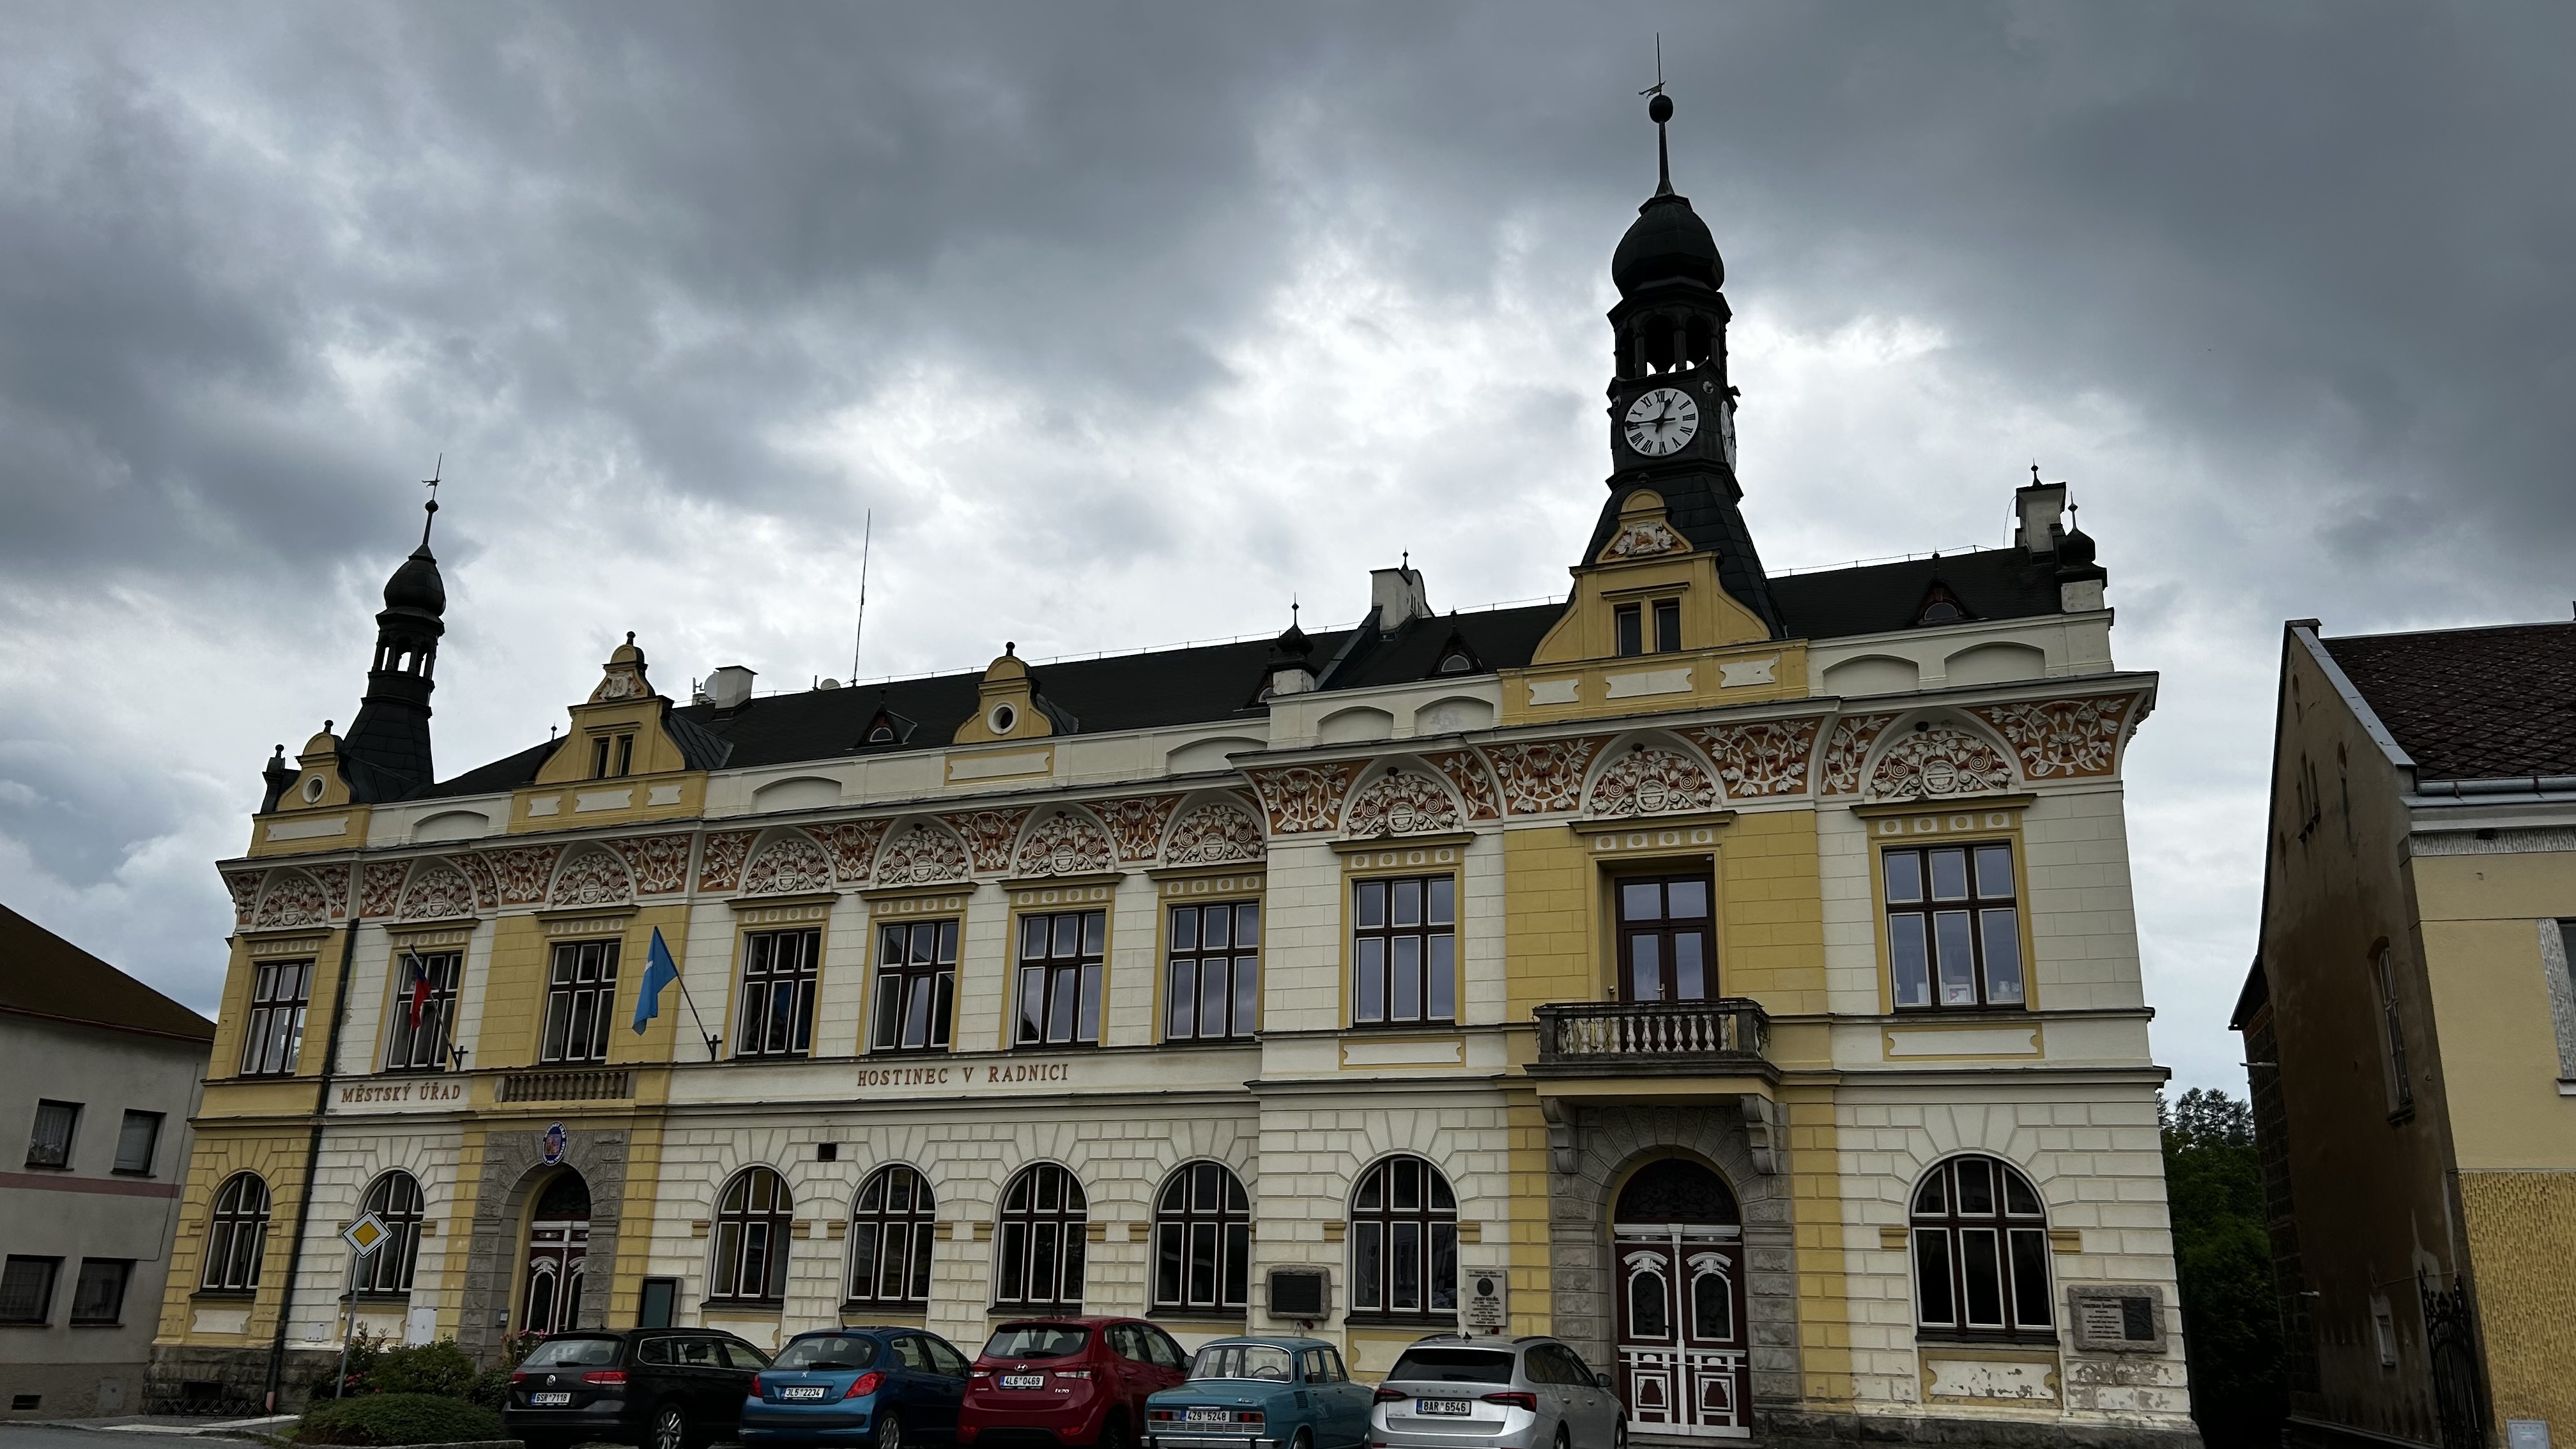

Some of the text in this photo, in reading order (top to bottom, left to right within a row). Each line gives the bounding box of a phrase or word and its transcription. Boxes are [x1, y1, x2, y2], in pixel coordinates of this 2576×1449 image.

[857, 1064, 1069, 1086] HOSTINEC V RADNICI
[341, 1082, 461, 1103] MĚSTSKÝ ÚŘAD
[1005, 1377, 1040, 1385] 4L6 0469
[536, 1393, 568, 1402] 6SR 7118
[786, 1388, 820, 1397] 3L5 2234
[1423, 1402, 1466, 1412] 8AR 6546
[1187, 1411, 1226, 1421] 4Z9 5248
